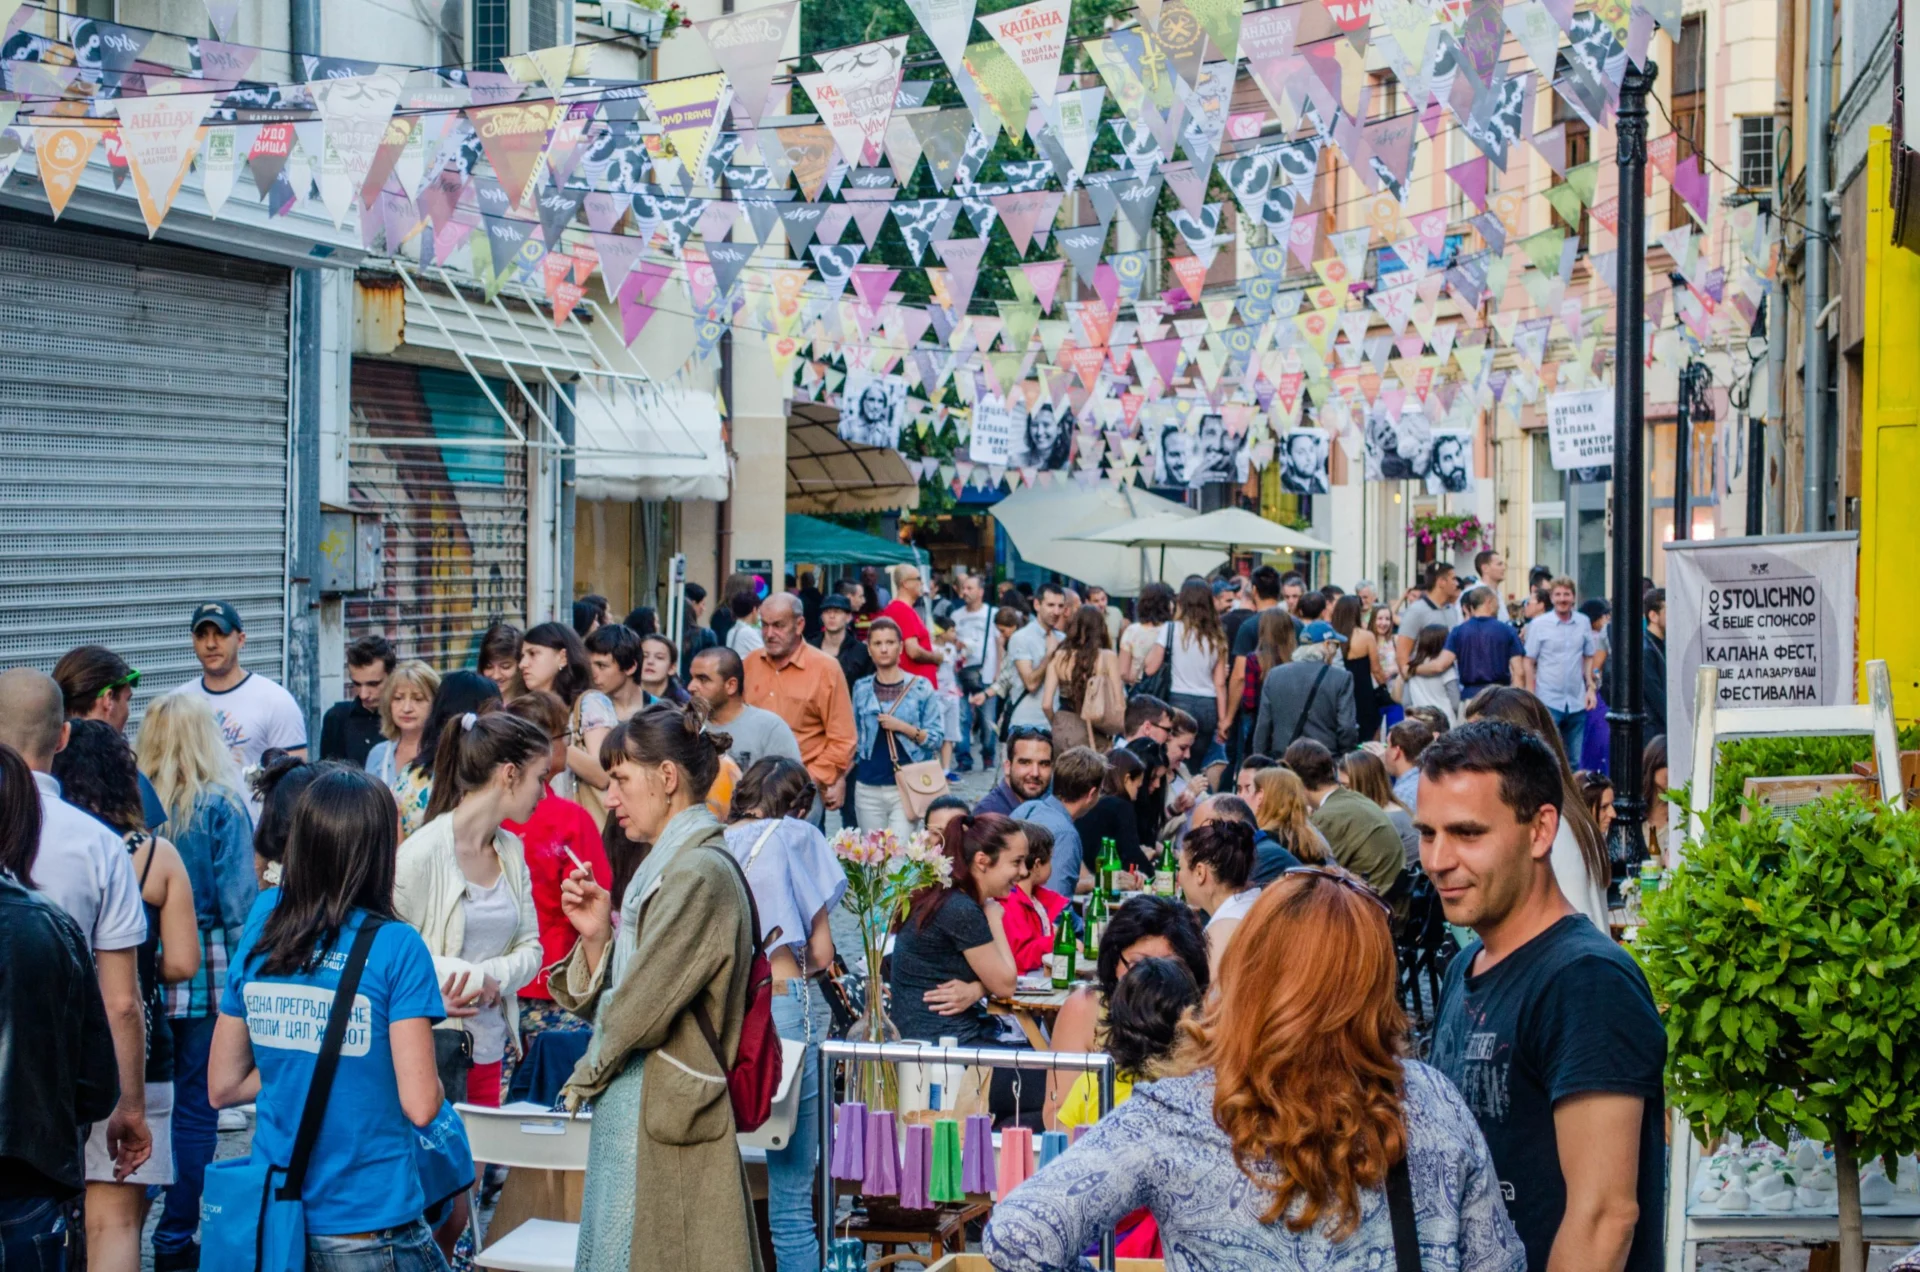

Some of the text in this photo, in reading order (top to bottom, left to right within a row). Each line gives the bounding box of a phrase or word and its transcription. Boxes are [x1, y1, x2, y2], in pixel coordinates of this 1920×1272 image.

[1000, 10, 1063, 38] КАПАНА
[1021, 44, 1052, 57] ДУШАТА
[254, 141, 288, 154] ВИЩА
[1555, 404, 1593, 415] ЛИЦАТА
[1556, 417, 1566, 425] ОТ
[1556, 424, 1596, 436] КАПАНА
[1573, 435, 1612, 447] ВИКТОР
[1580, 445, 1614, 457] ЦОНЕВ
[1722, 585, 1816, 610] STOLICHNO
[1708, 589, 1720, 630] АКО
[1722, 612, 1816, 630] БЕШЕ СПОНСОР
[1706, 643, 1817, 663] КАПАНА ФЕСТ,
[1737, 668, 1753, 680] ДА
[1755, 666, 1816, 679] ПАЗАРУВАШ
[1719, 684, 1816, 701] ФЕСТИВАЛНА
[246, 995, 272, 1014] ЕДНА
[275, 996, 331, 1021] ПРЕГРЪД
[285, 1020, 310, 1040] ЦЯЛ
[314, 1024, 366, 1046] ЖОТ
